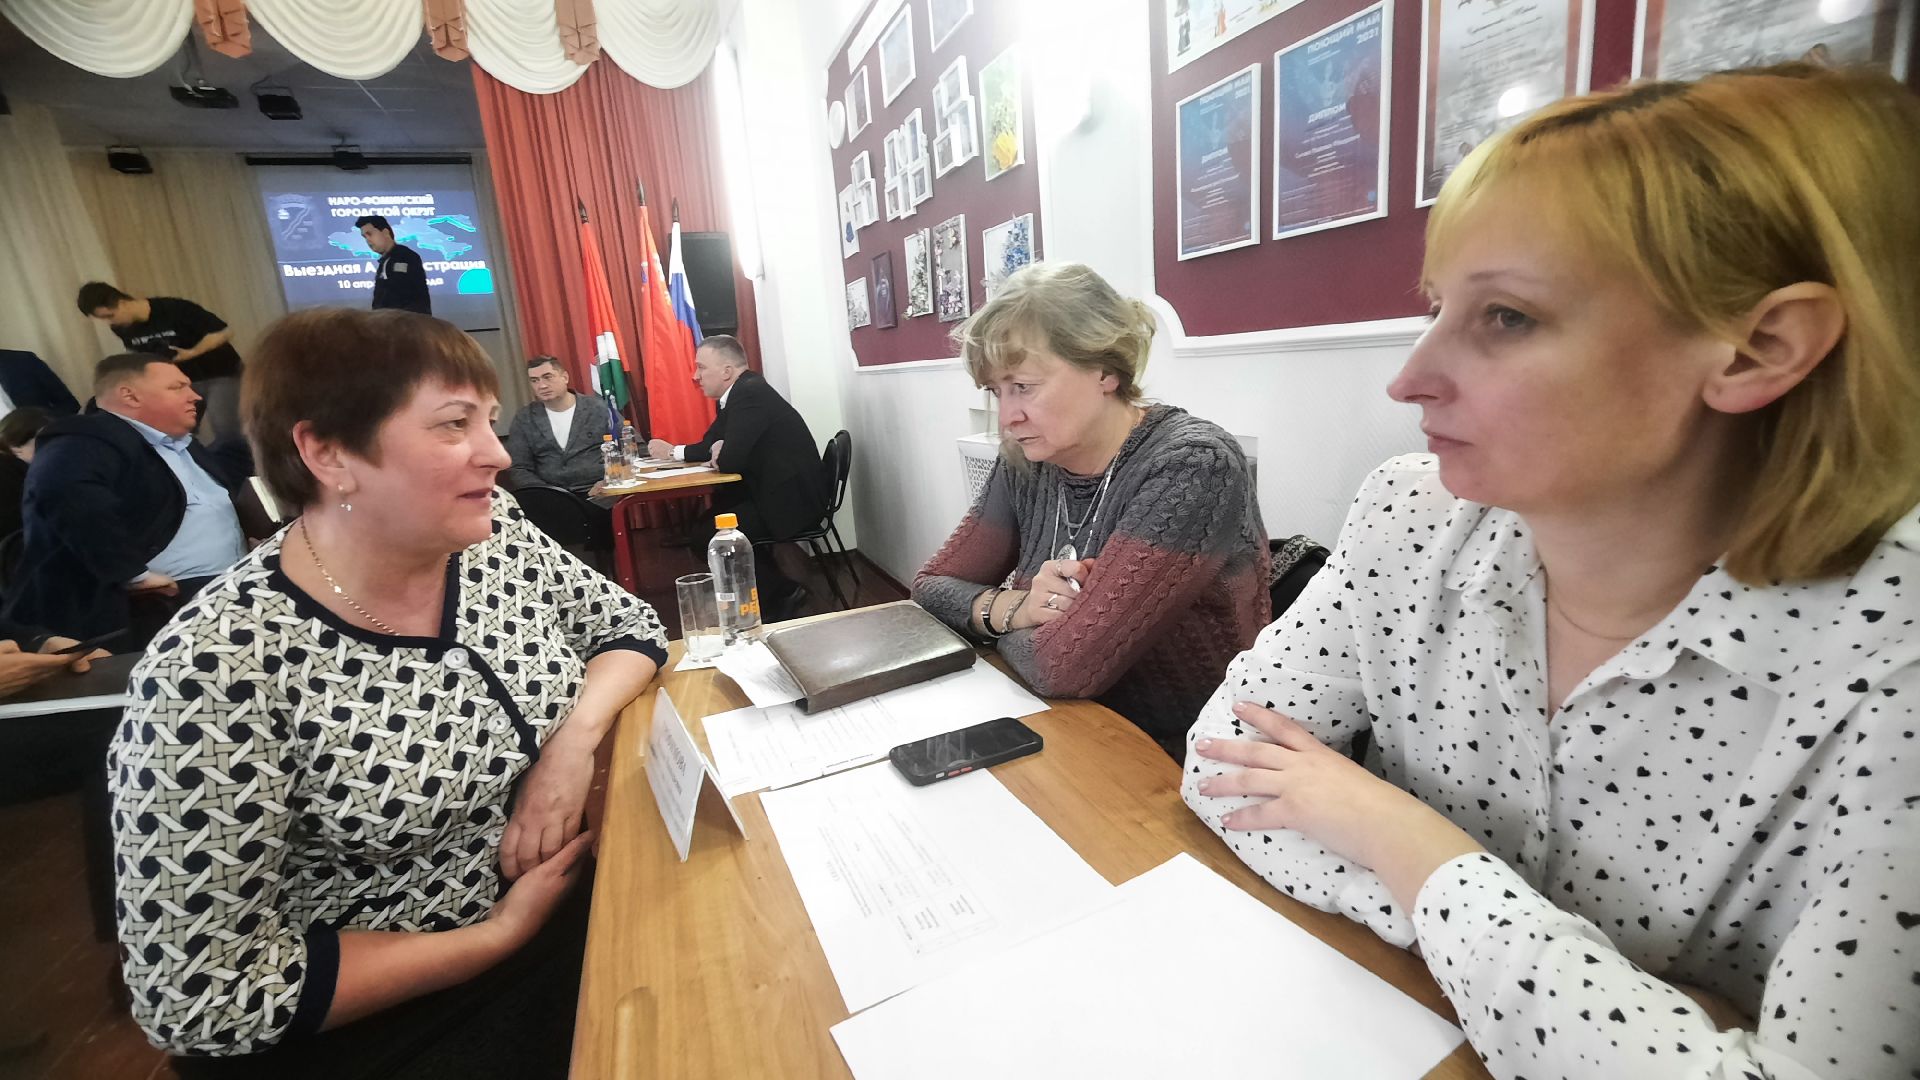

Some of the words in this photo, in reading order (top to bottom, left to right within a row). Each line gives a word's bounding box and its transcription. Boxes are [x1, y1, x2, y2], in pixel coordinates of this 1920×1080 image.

[1356, 11, 1380, 32] МАЙ
[328, 194, 435, 205] НАРО-ФОМИНСКИЙ
[330, 206, 400, 217] ГОРОДСКОЙ
[401, 206, 435, 216] ОКРУГ
[283, 263, 361, 277] Выездная
[337, 279, 351, 289] 10
